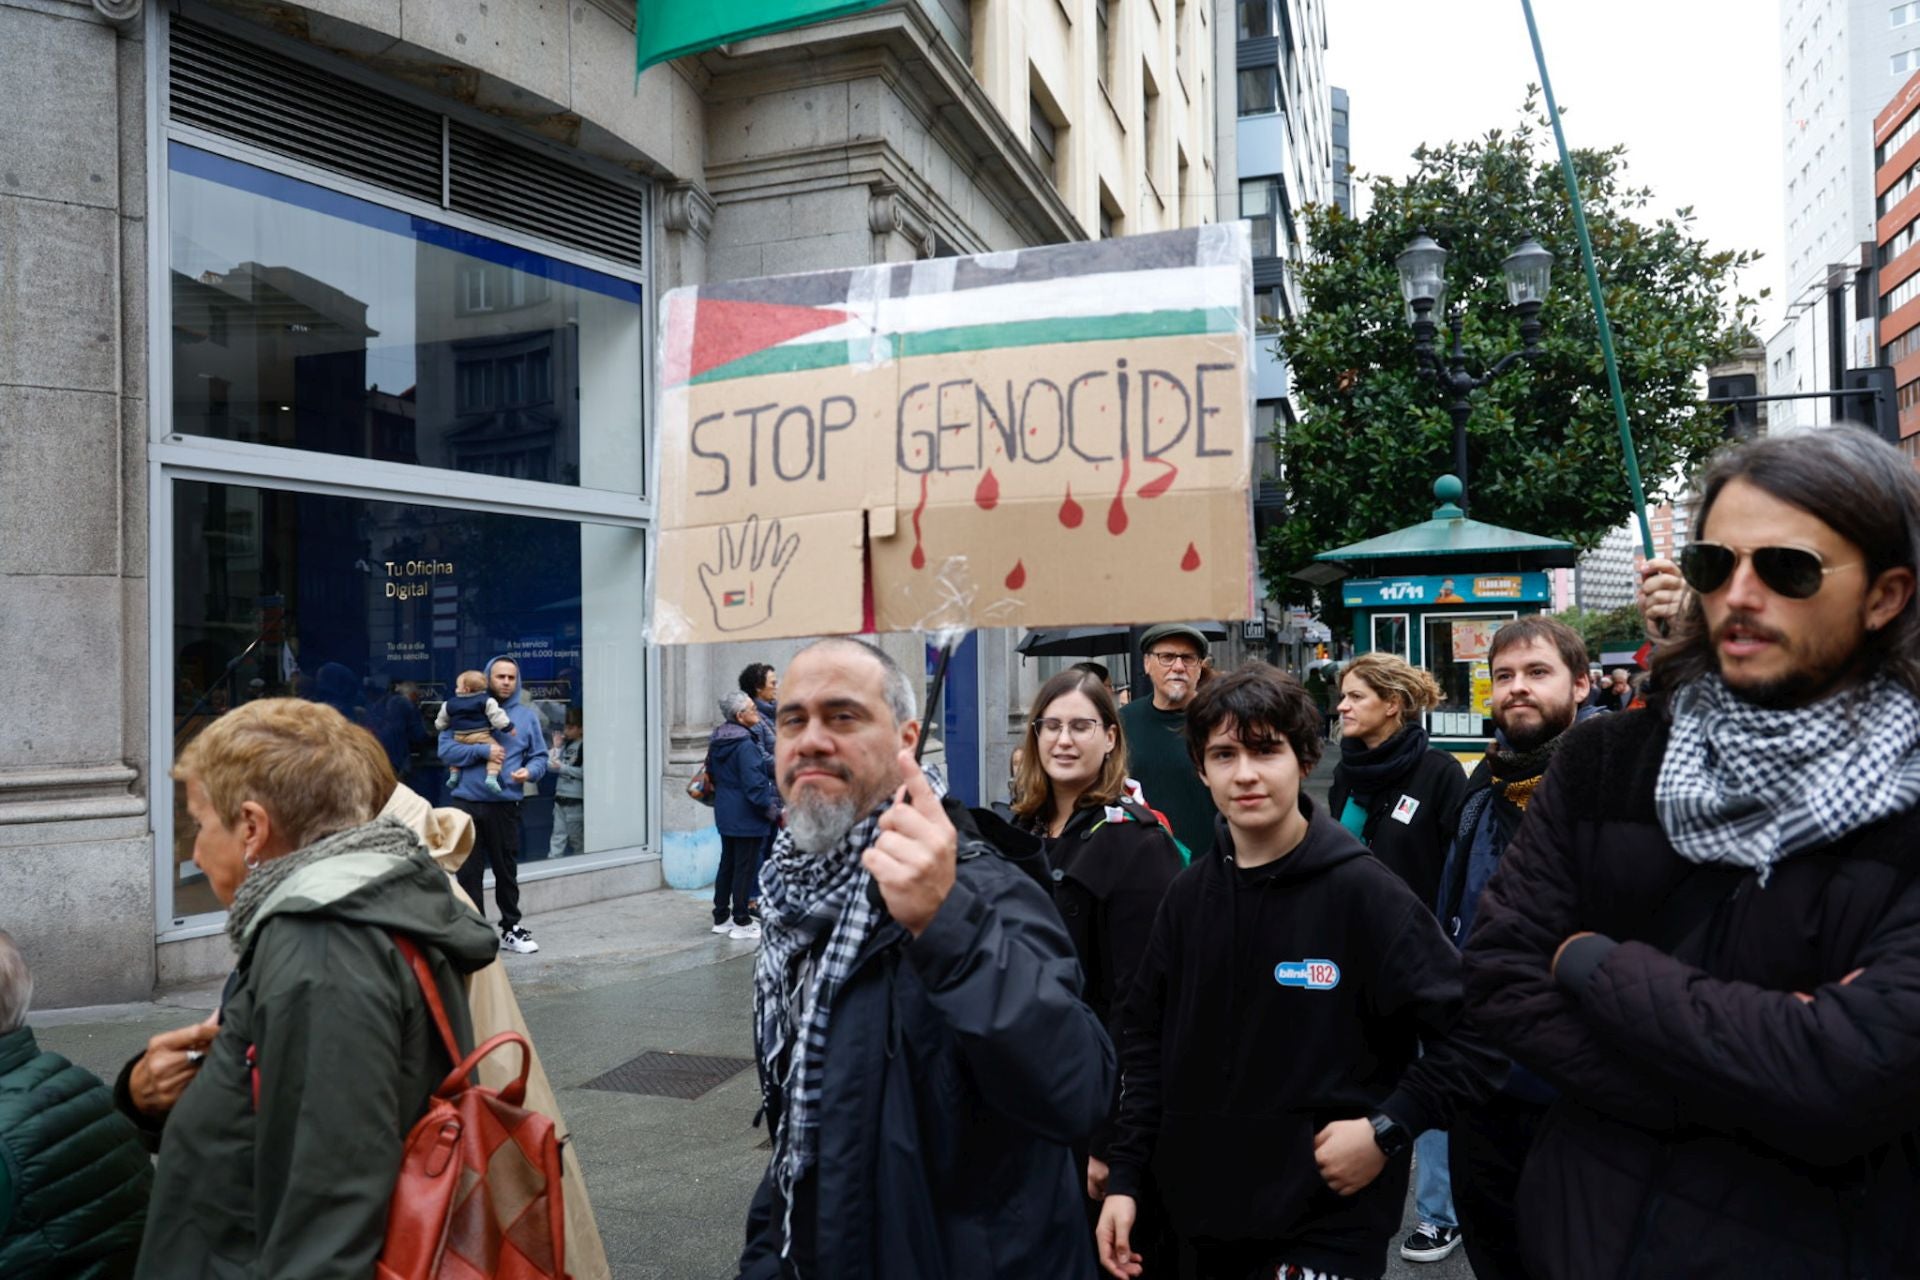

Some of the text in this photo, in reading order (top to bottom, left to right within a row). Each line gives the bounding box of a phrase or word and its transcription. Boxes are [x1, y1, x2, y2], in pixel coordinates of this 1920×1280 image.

[691, 395, 856, 496] STOP
[385, 559, 453, 576] Tu Oficina
[385, 581, 428, 600] Digital
[1379, 585, 1424, 600] 11/11
[522, 640, 549, 648] servicio
[532, 649, 553, 658] 6.000
[529, 686, 561, 697] BBVA
